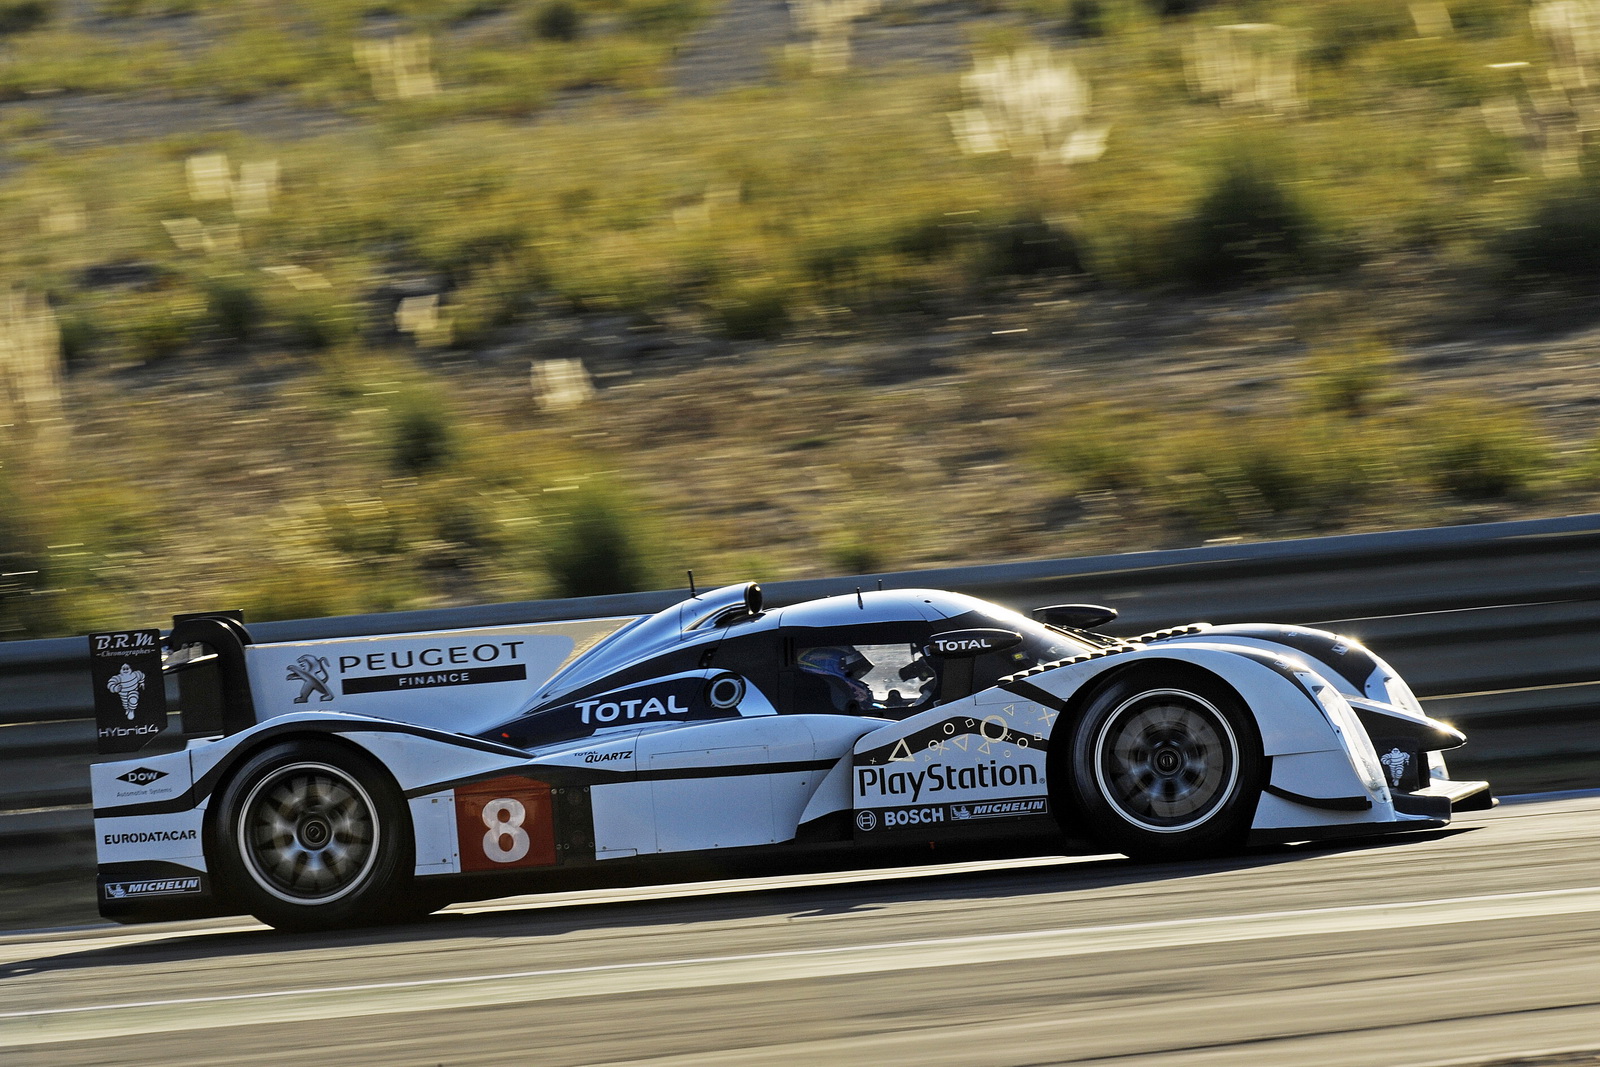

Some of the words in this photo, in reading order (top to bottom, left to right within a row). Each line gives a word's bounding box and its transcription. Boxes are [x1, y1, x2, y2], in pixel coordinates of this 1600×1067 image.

[935, 639, 992, 652] TOTAL
[339, 641, 525, 673] PEUGEOT
[398, 672, 470, 687] FINANCE
[574, 695, 689, 725] TOTAL
[584, 750, 634, 764] QUARTZ
[116, 789, 148, 798] Automotive
[149, 787, 172, 795] Systems
[884, 807, 945, 827] BOSCH
[973, 800, 1044, 815] MICHELIN
[104, 829, 197, 845] EURODATACAR
[482, 798, 530, 863] 8
[128, 879, 198, 893] MICHELIN
